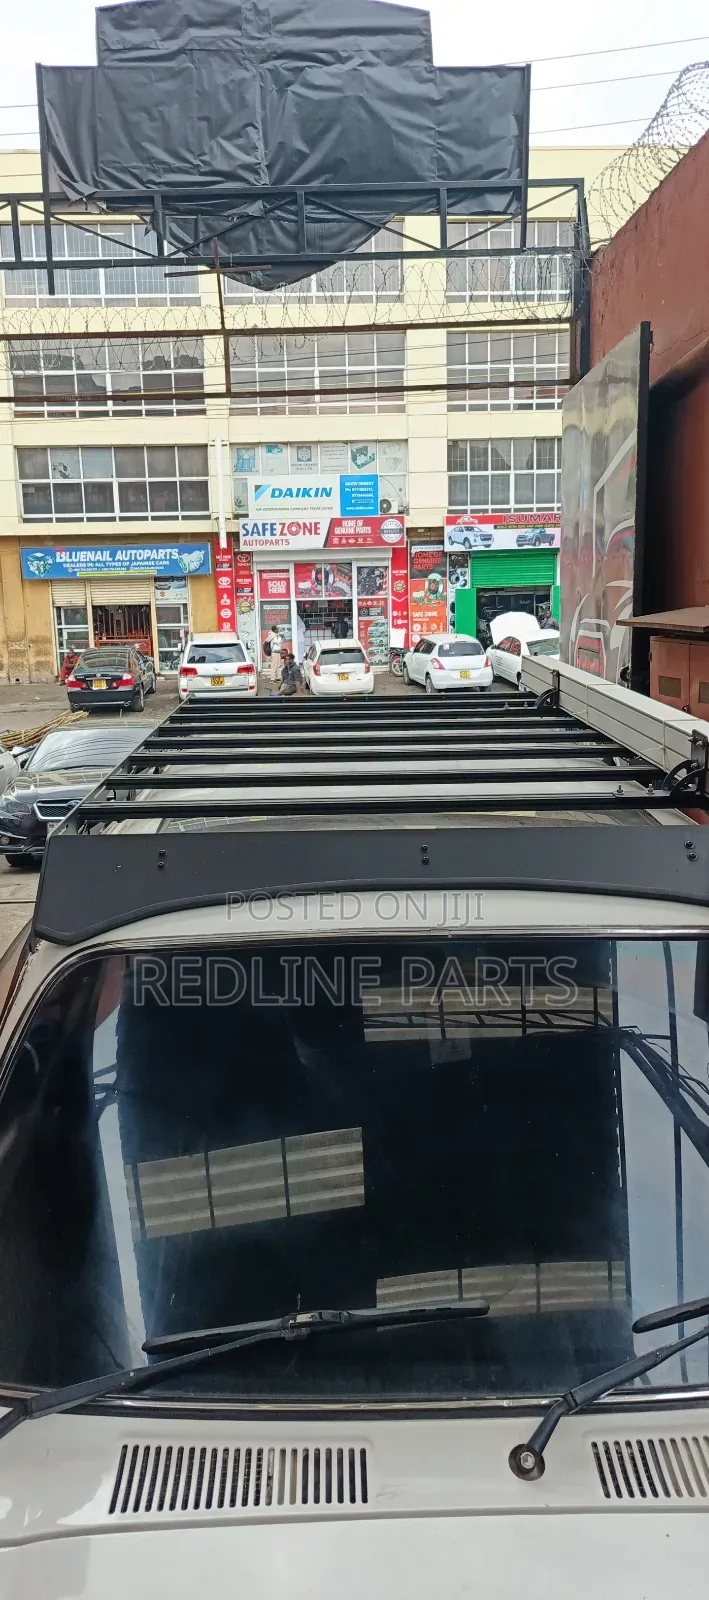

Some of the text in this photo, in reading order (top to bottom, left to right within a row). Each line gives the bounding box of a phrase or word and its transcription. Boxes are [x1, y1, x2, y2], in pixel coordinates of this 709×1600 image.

[270, 487, 333, 499] DAIKIN
[342, 519, 363, 527] HOME OF
[335, 526, 372, 535] GENUINE PARTS
[243, 538, 290, 547] AUTOPARTS
[56, 549, 179, 563] BLUENAIL AUTOPARTS
[268, 586, 287, 594] HERE
